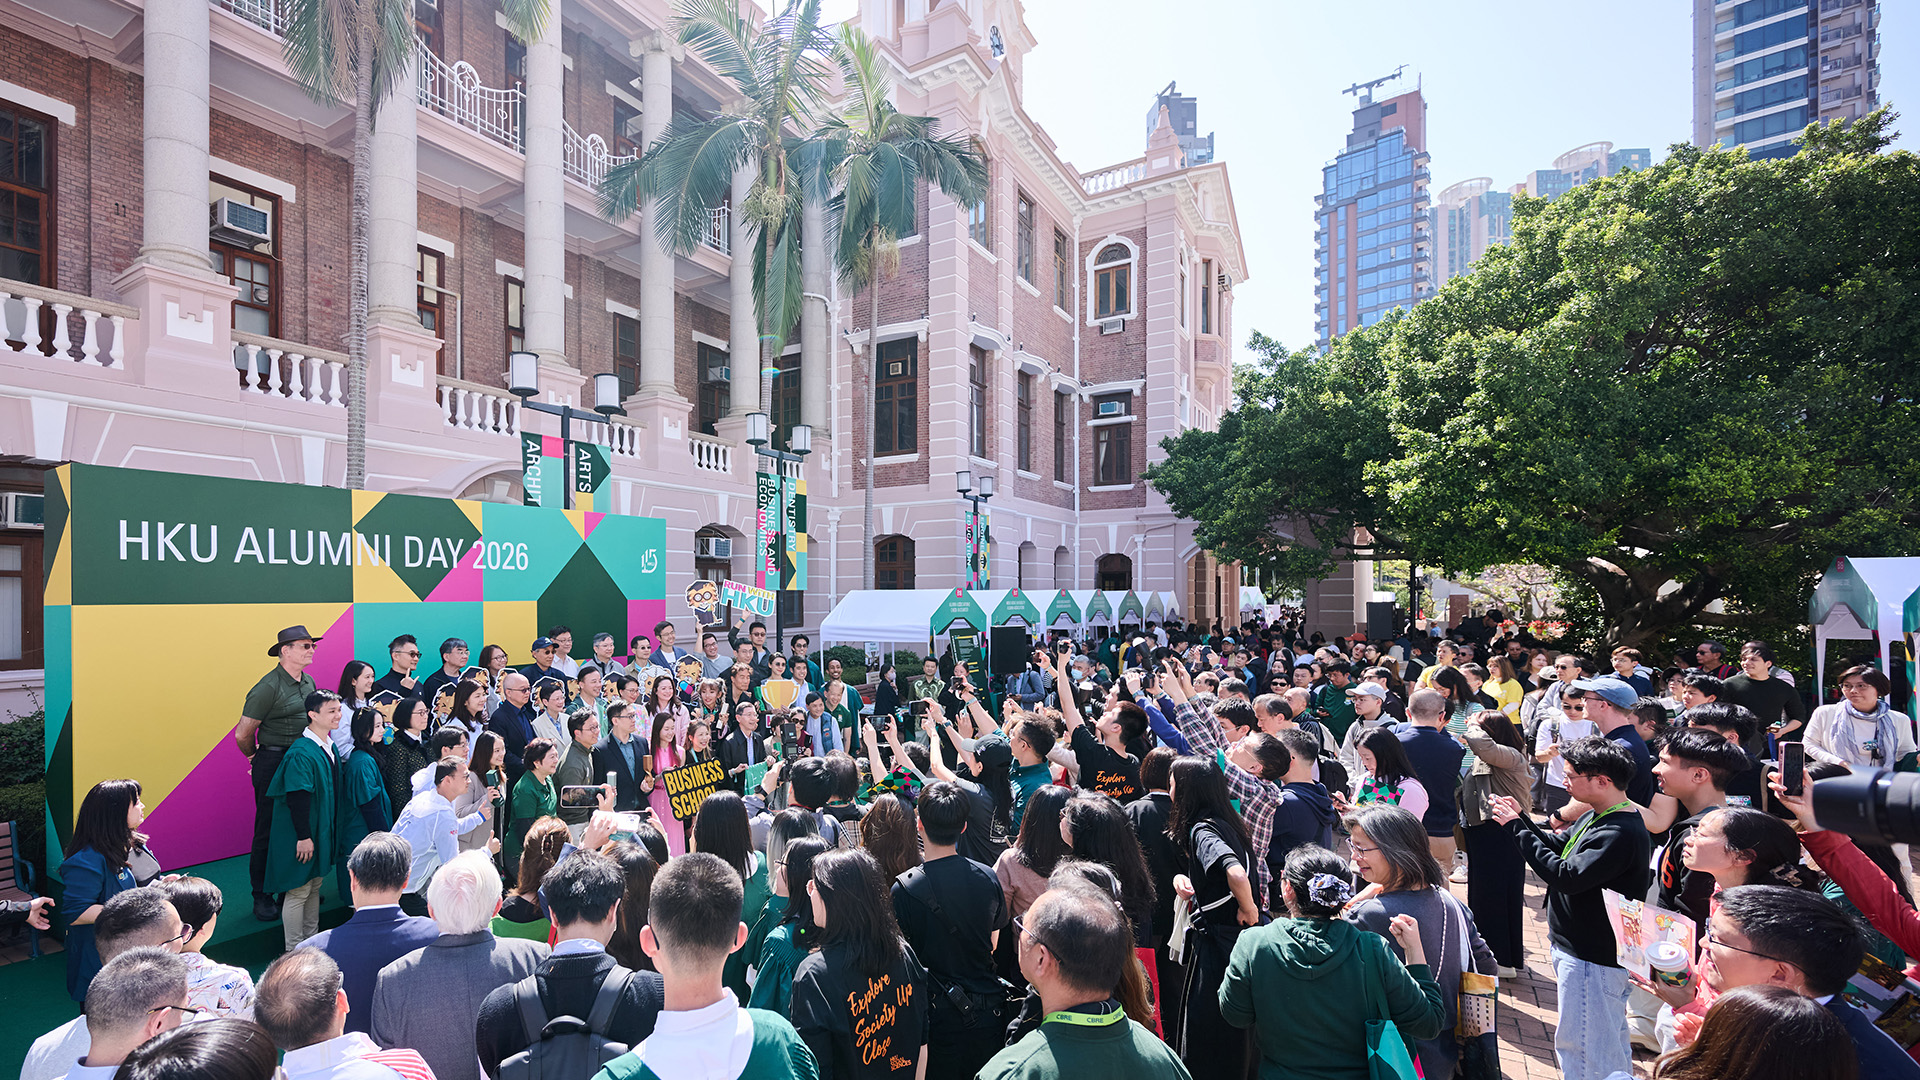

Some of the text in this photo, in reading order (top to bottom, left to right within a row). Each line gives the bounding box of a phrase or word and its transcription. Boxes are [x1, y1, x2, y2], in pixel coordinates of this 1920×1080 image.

[526, 439, 541, 506] ARCHIT
[579, 448, 592, 493] ARTS
[759, 477, 768, 556] ECONOMICS
[767, 479, 776, 576] BUSINESS AND
[788, 482, 796, 551] DENTISTRY
[118, 519, 529, 571] HKU ALUMNI DAY 2026
[721, 587, 774, 616] HKU
[724, 580, 747, 593] RUN
[664, 759, 725, 796] BUSINESS
[1096, 770, 1126, 786] Explore
[847, 973, 891, 1017] Explore
[855, 983, 913, 1048] Society Up
[862, 1036, 892, 1065] Close
